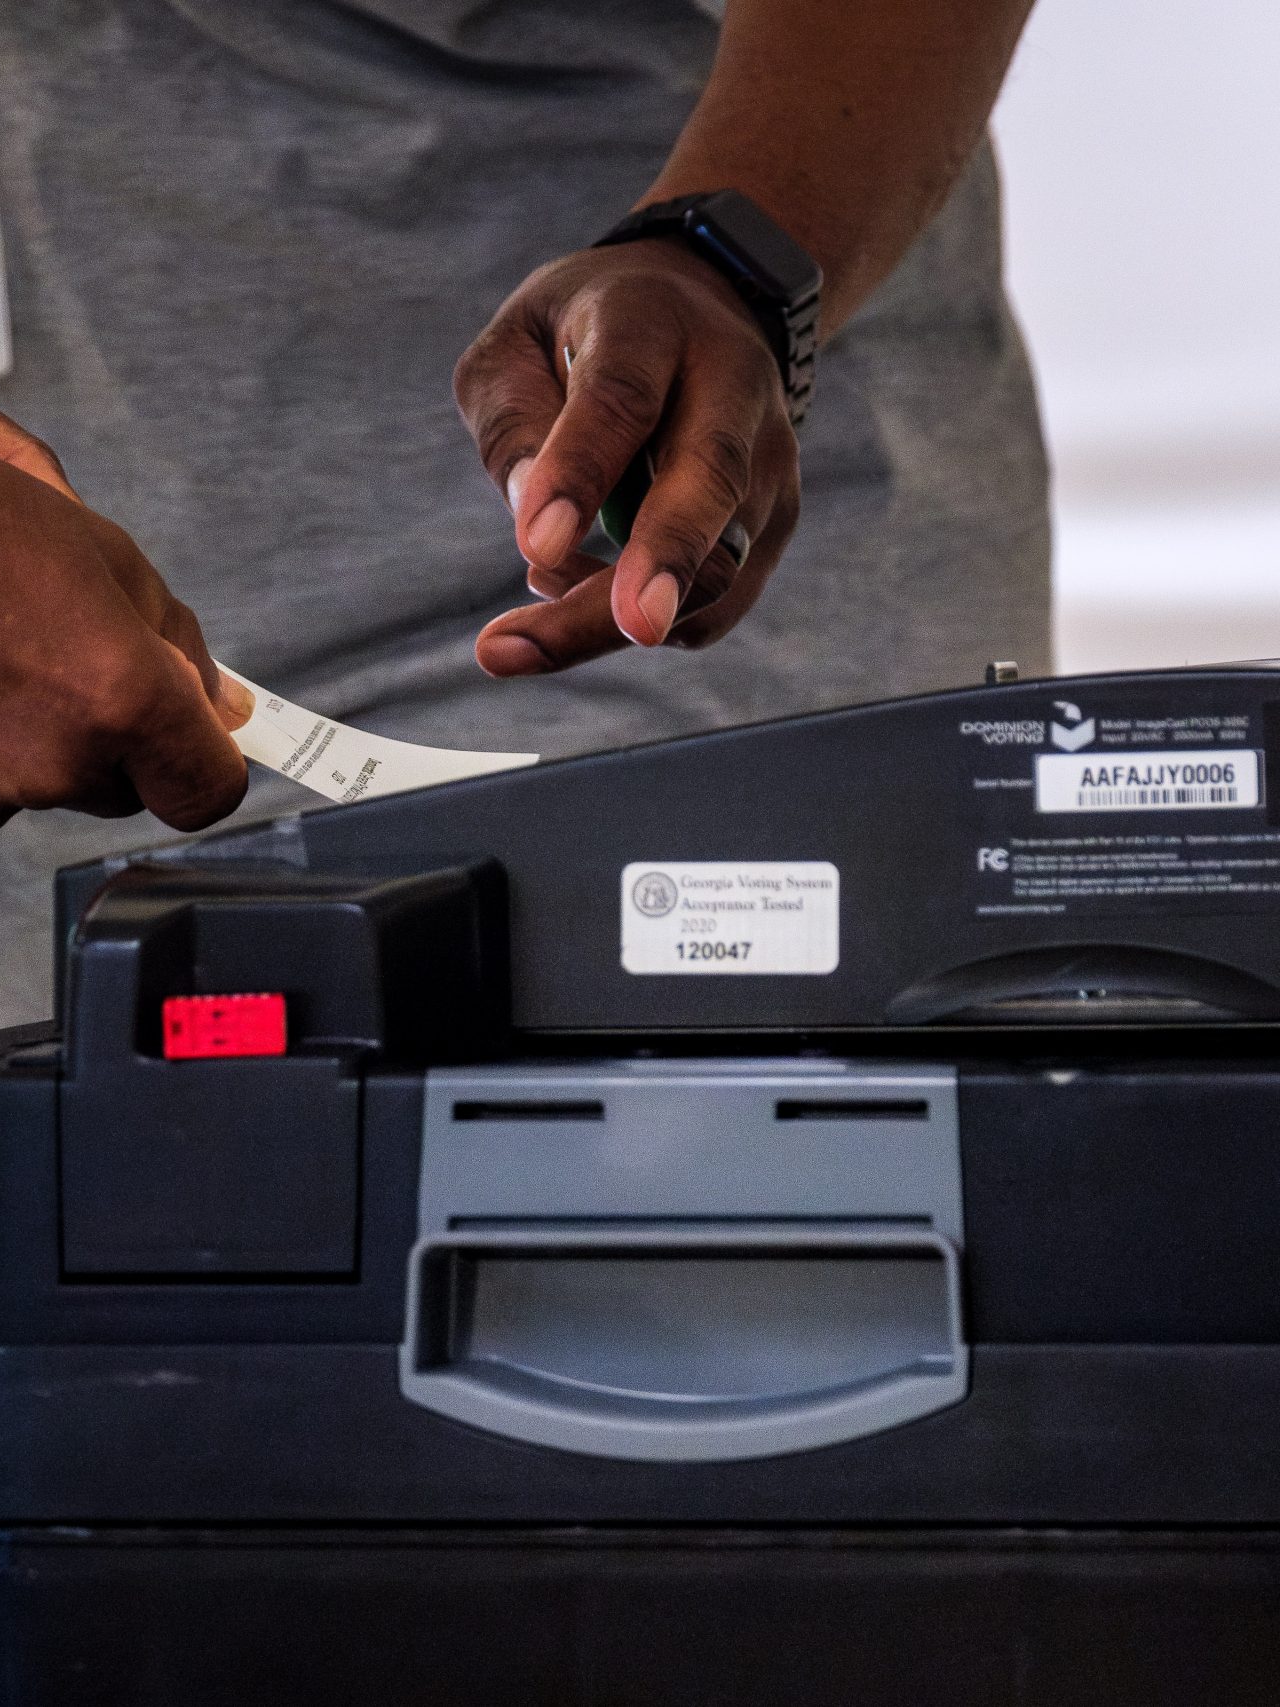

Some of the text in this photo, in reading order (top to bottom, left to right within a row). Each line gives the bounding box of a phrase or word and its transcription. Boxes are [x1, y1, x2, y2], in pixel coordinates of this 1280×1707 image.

[960, 720, 1045, 734] DOMINION
[982, 732, 1044, 744] VOTING
[1081, 764, 1235, 787] AAFAJJY0006
[681, 875, 832, 891] Georgia Voting System
[681, 897, 803, 913] Acceptance Tested
[681, 919, 717, 933] 2020
[676, 942, 752, 960] 120047
